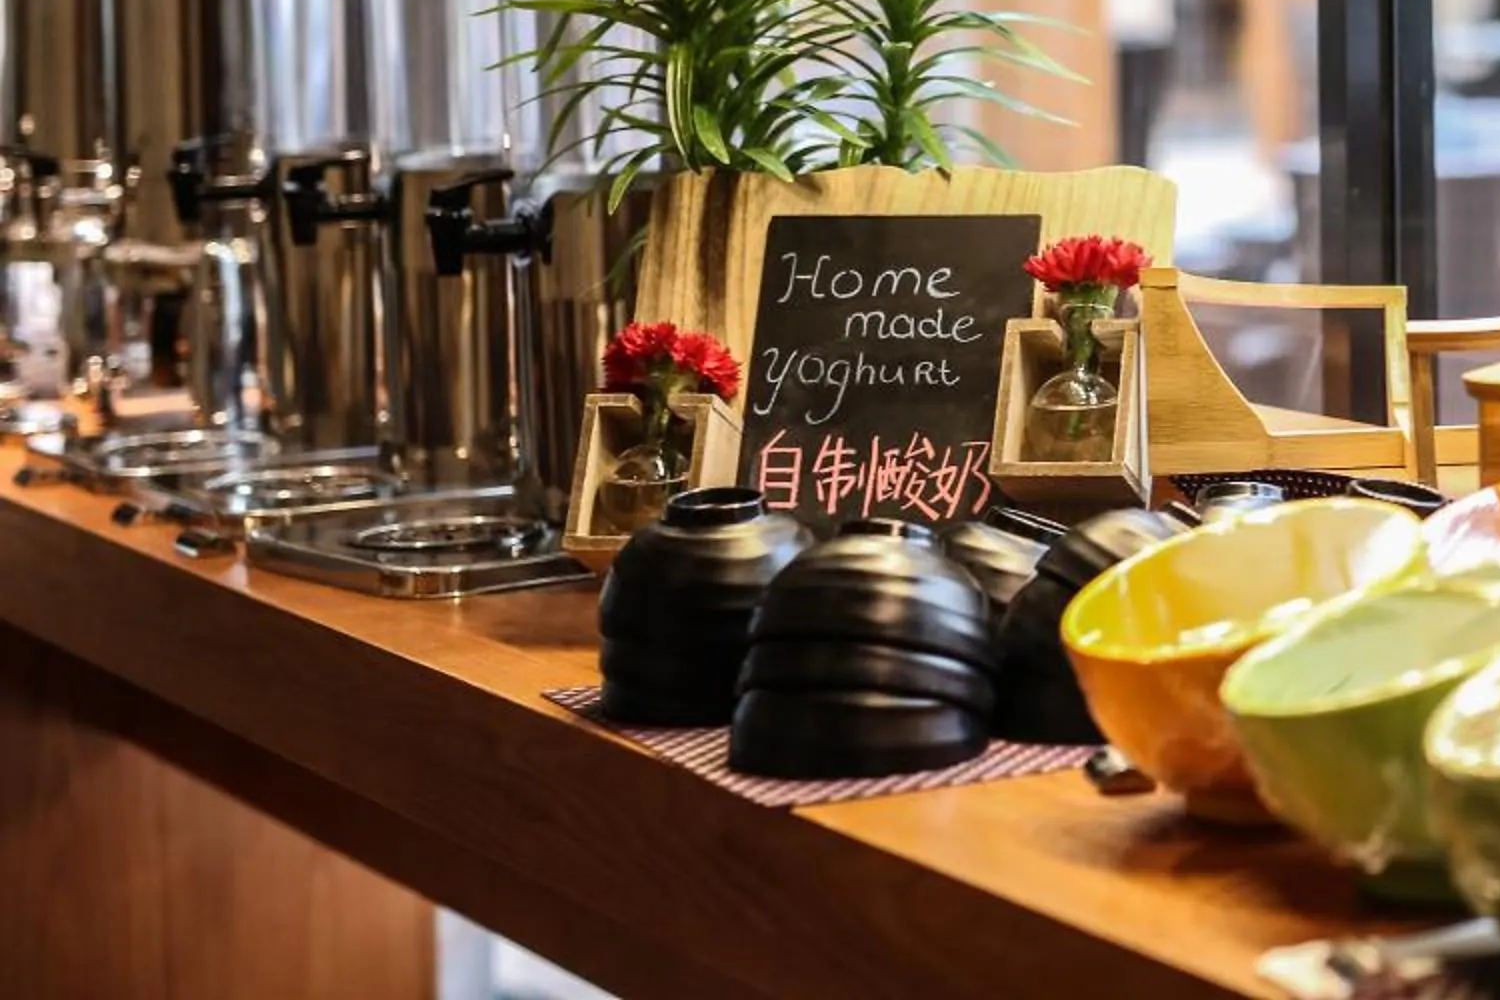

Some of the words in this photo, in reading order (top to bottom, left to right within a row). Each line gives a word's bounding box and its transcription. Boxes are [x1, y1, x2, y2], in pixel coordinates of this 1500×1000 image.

[777, 252, 961, 303] Home
[845, 308, 983, 343] made
[758, 429, 992, 521] 自制酸奶
